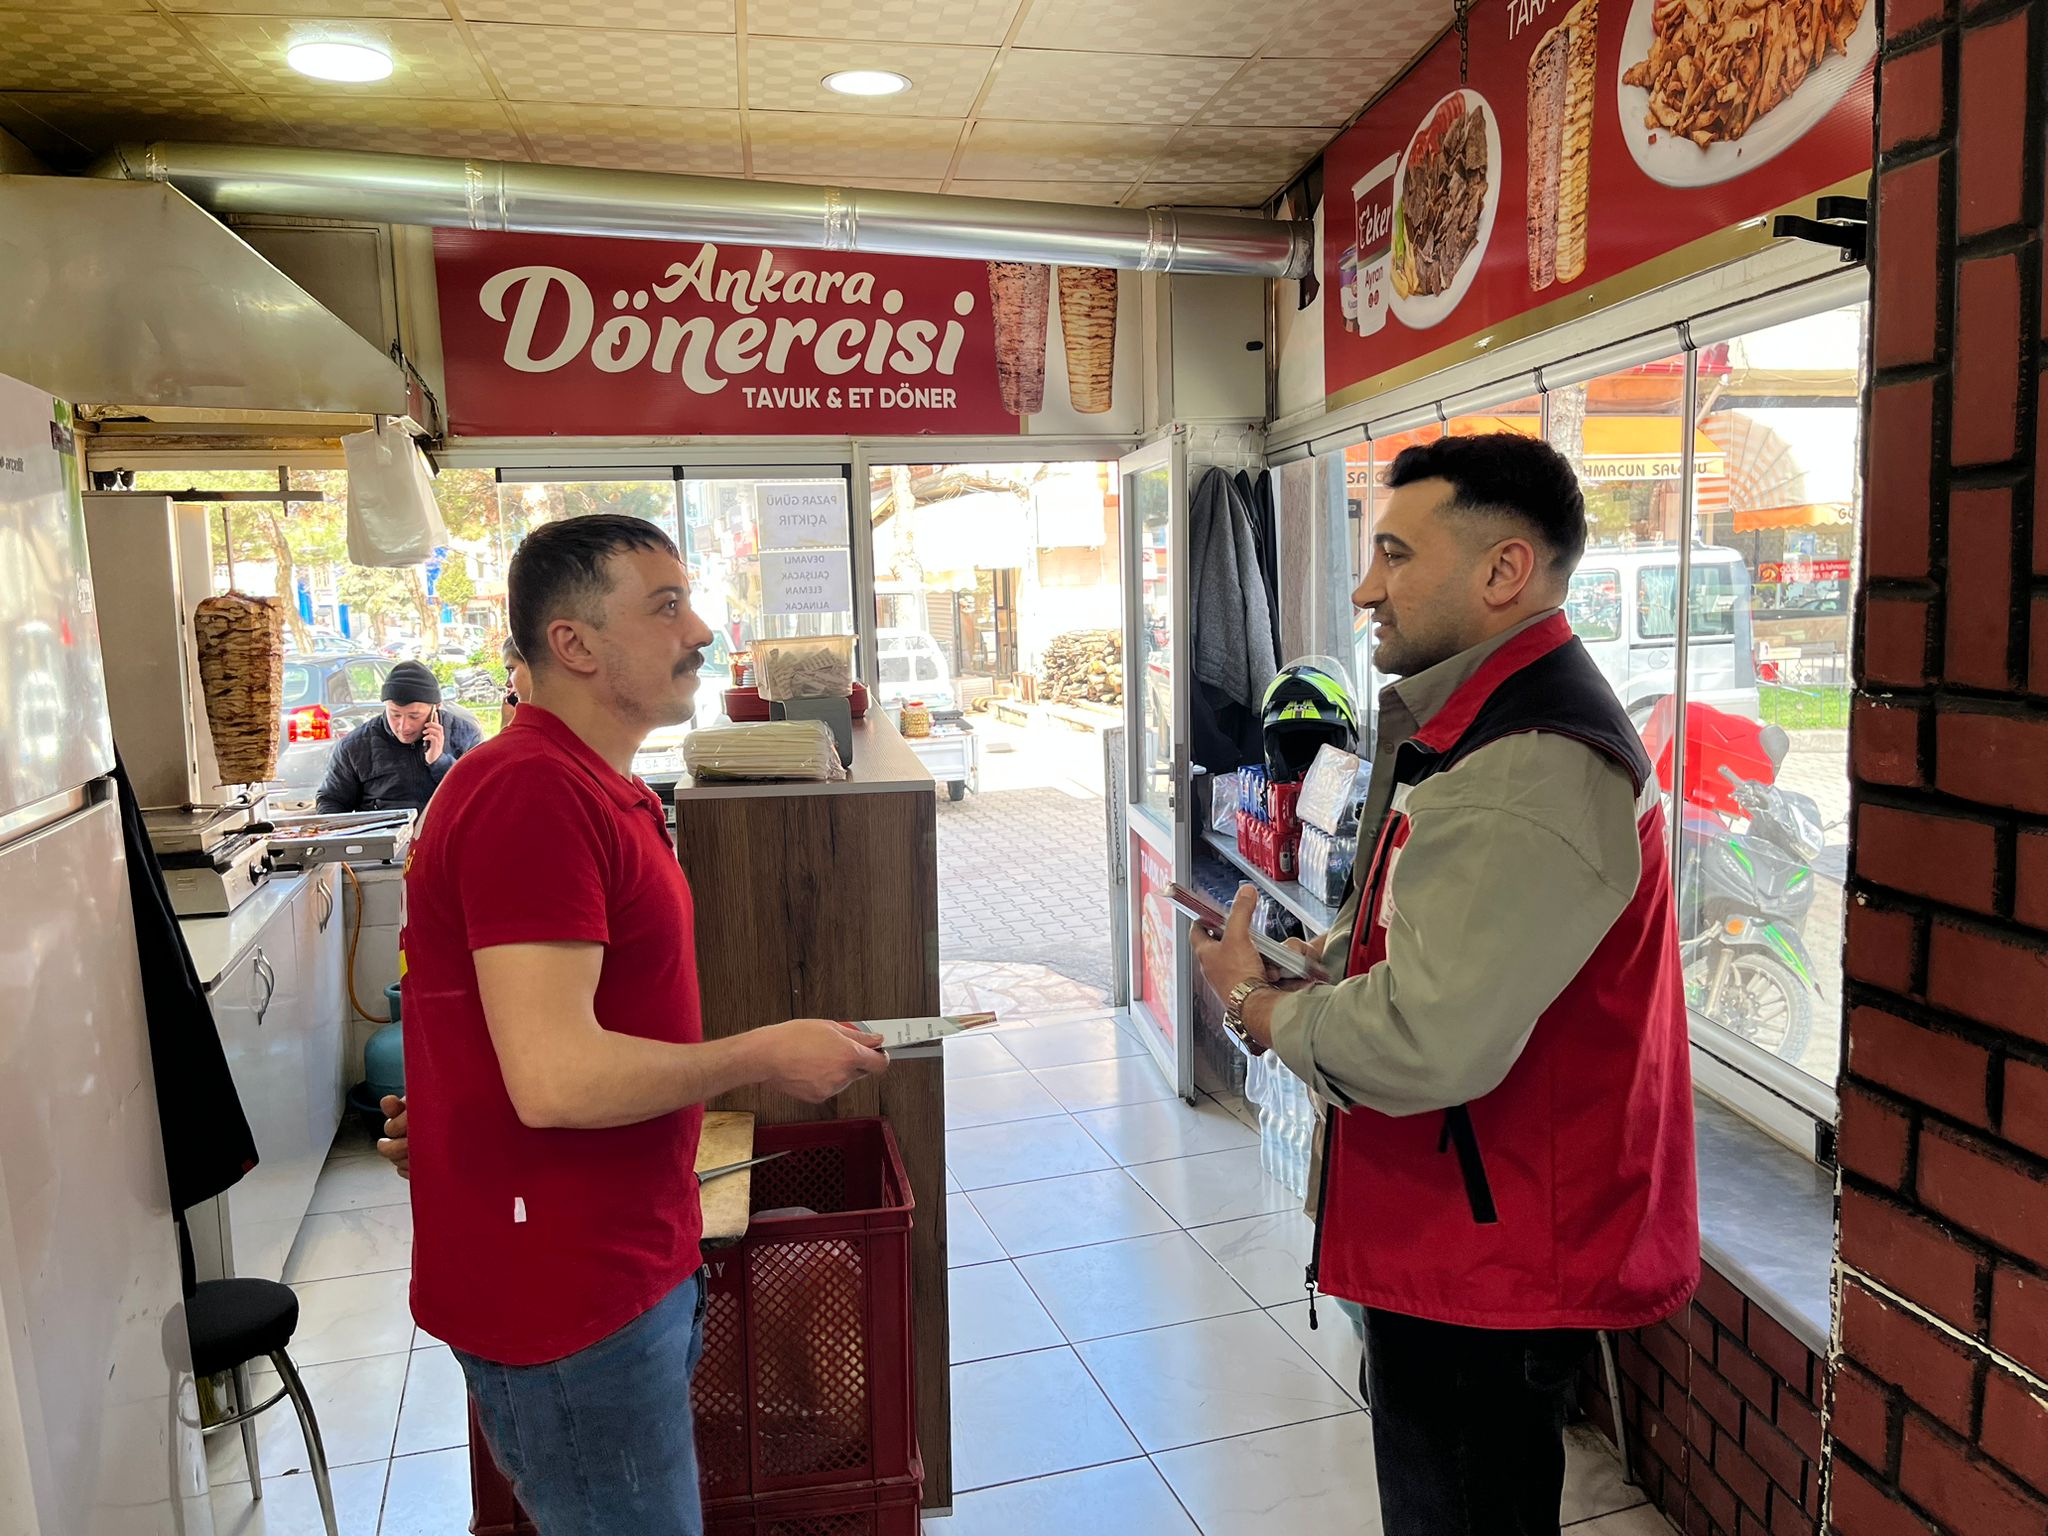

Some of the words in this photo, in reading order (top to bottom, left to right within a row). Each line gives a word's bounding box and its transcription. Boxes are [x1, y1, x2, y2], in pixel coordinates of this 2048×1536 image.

[651, 242, 876, 315] Ankara
[478, 265, 975, 395] Dönercisi
[742, 387, 821, 409] TAVUK
[826, 387, 842, 409] &
[848, 387, 874, 409] ET
[879, 382, 957, 410] DÖNER
